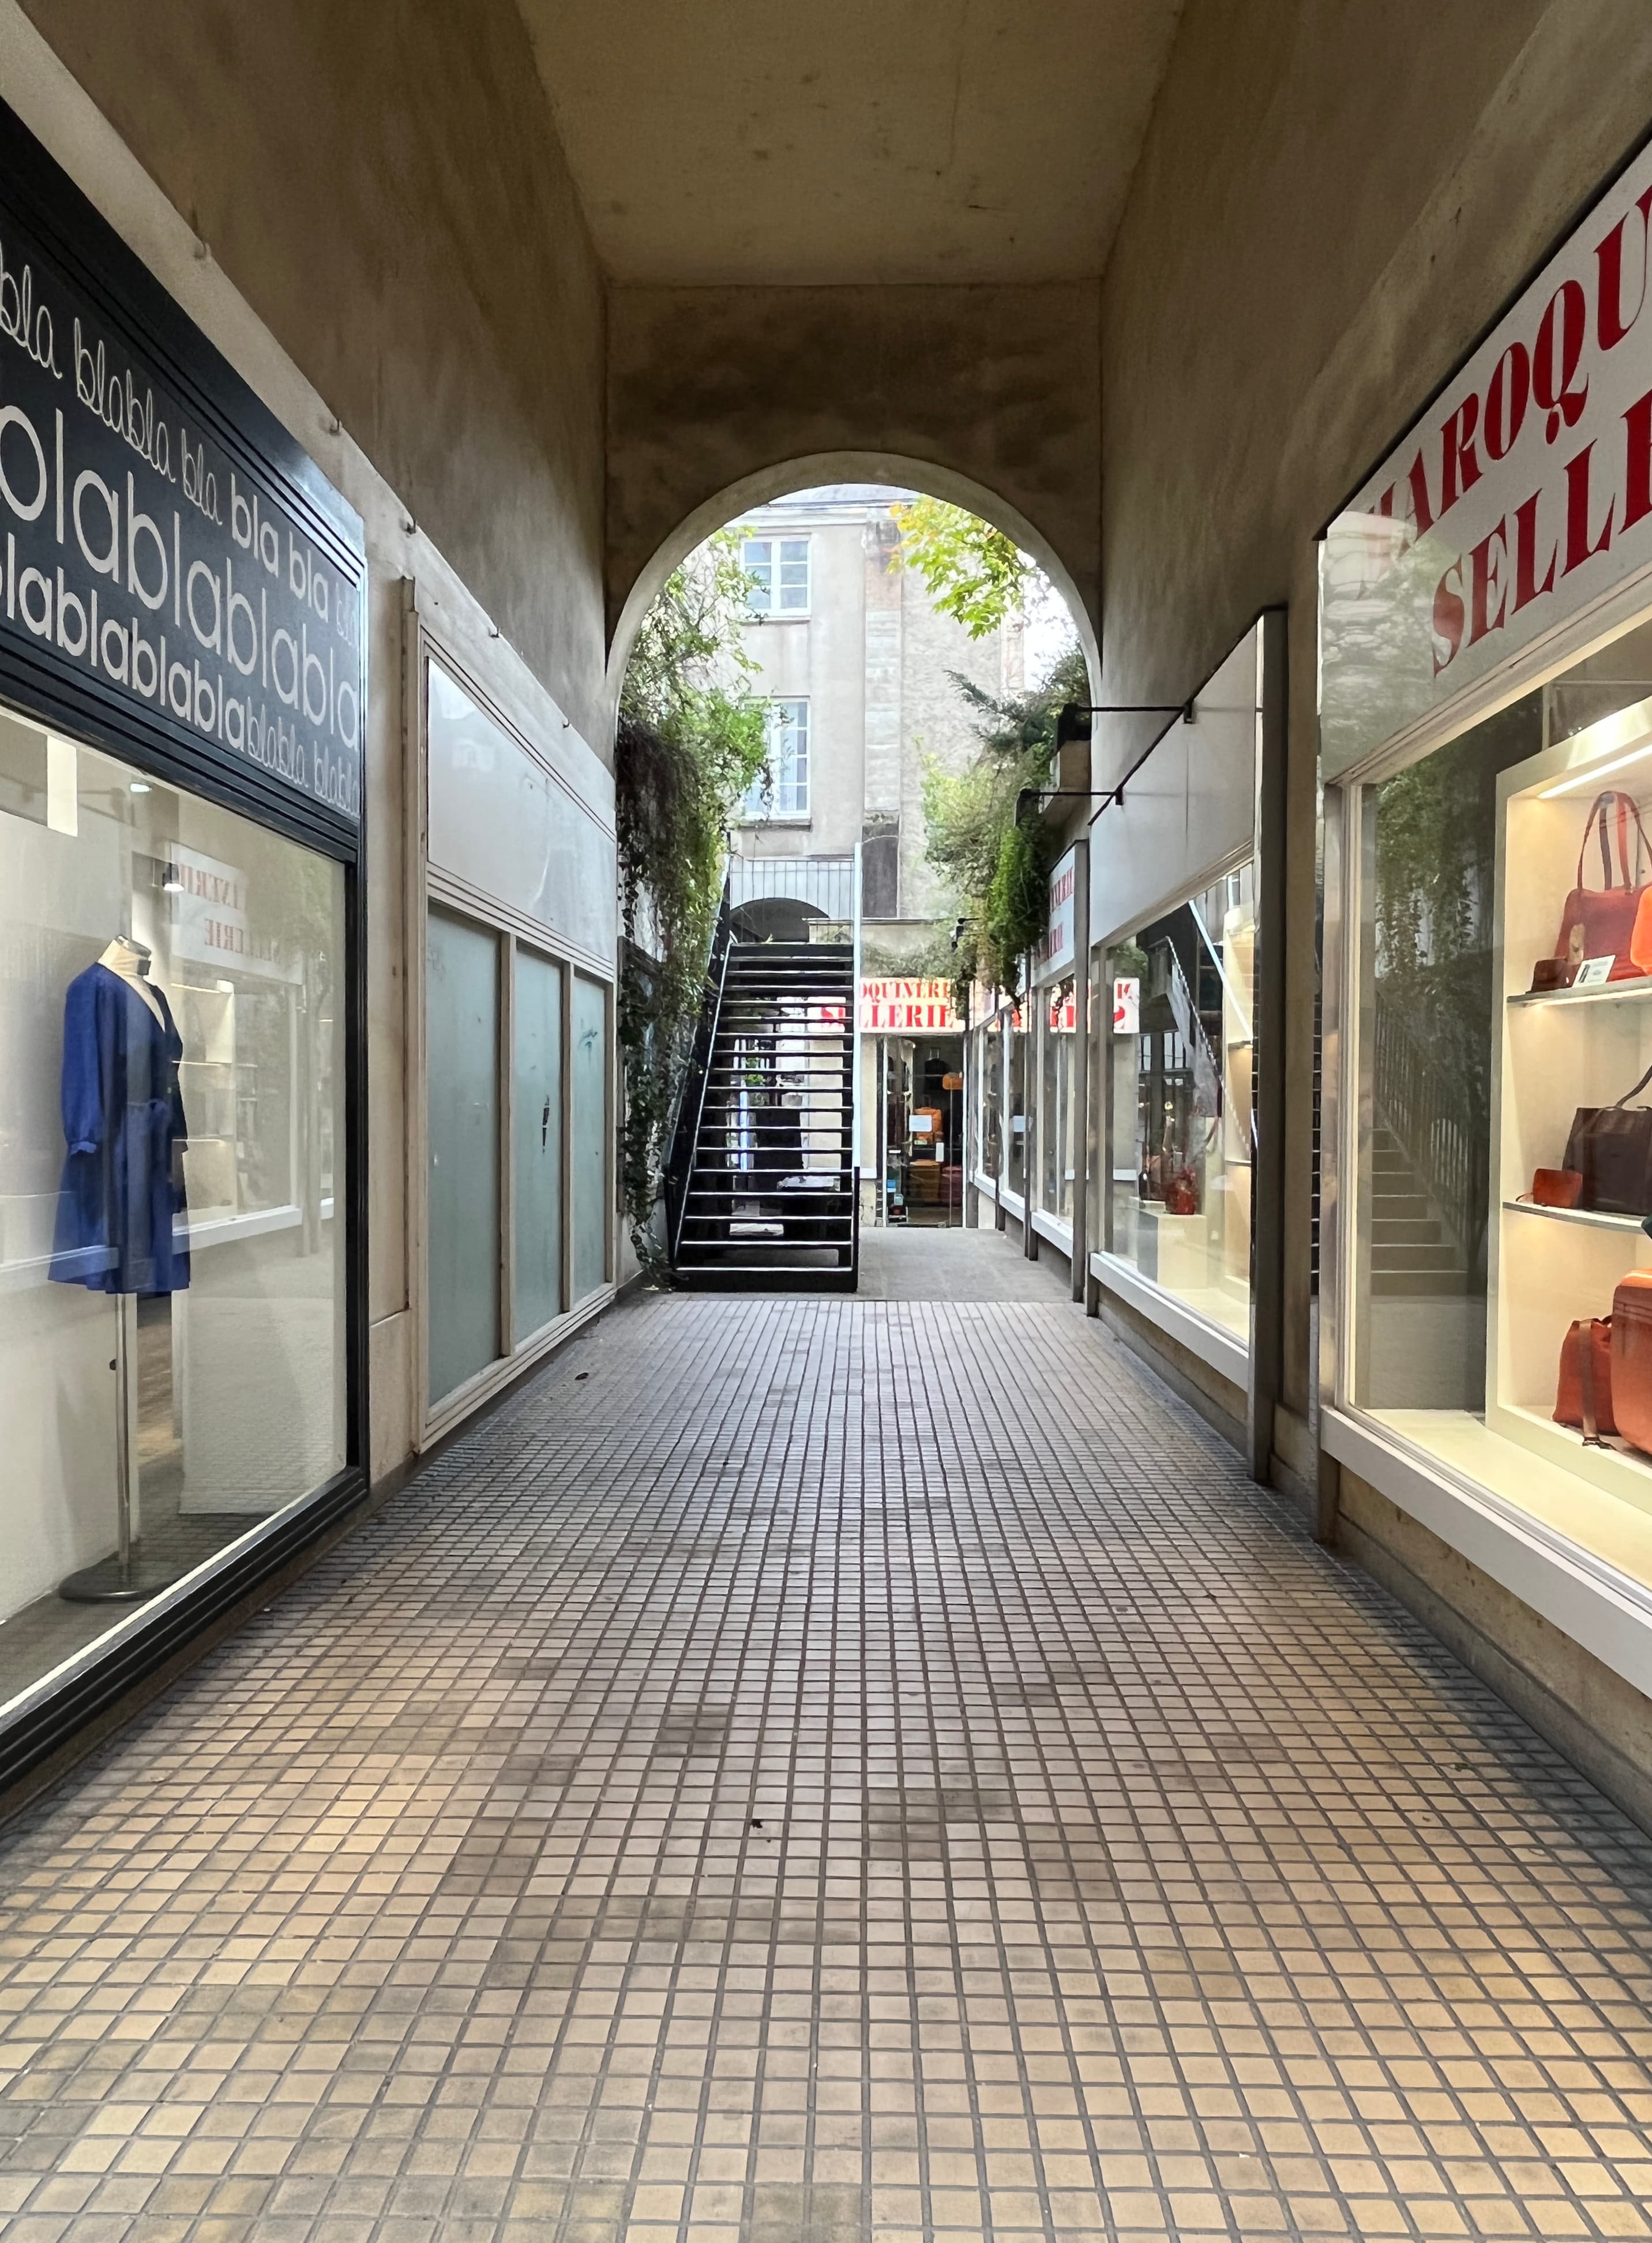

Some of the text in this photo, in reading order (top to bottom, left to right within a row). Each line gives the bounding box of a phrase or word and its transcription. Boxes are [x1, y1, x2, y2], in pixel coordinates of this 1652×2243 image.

[74, 317, 175, 482] blabla
[182, 429, 223, 525] bla
[231, 472, 279, 578] bla
[290, 531, 328, 624] bla
